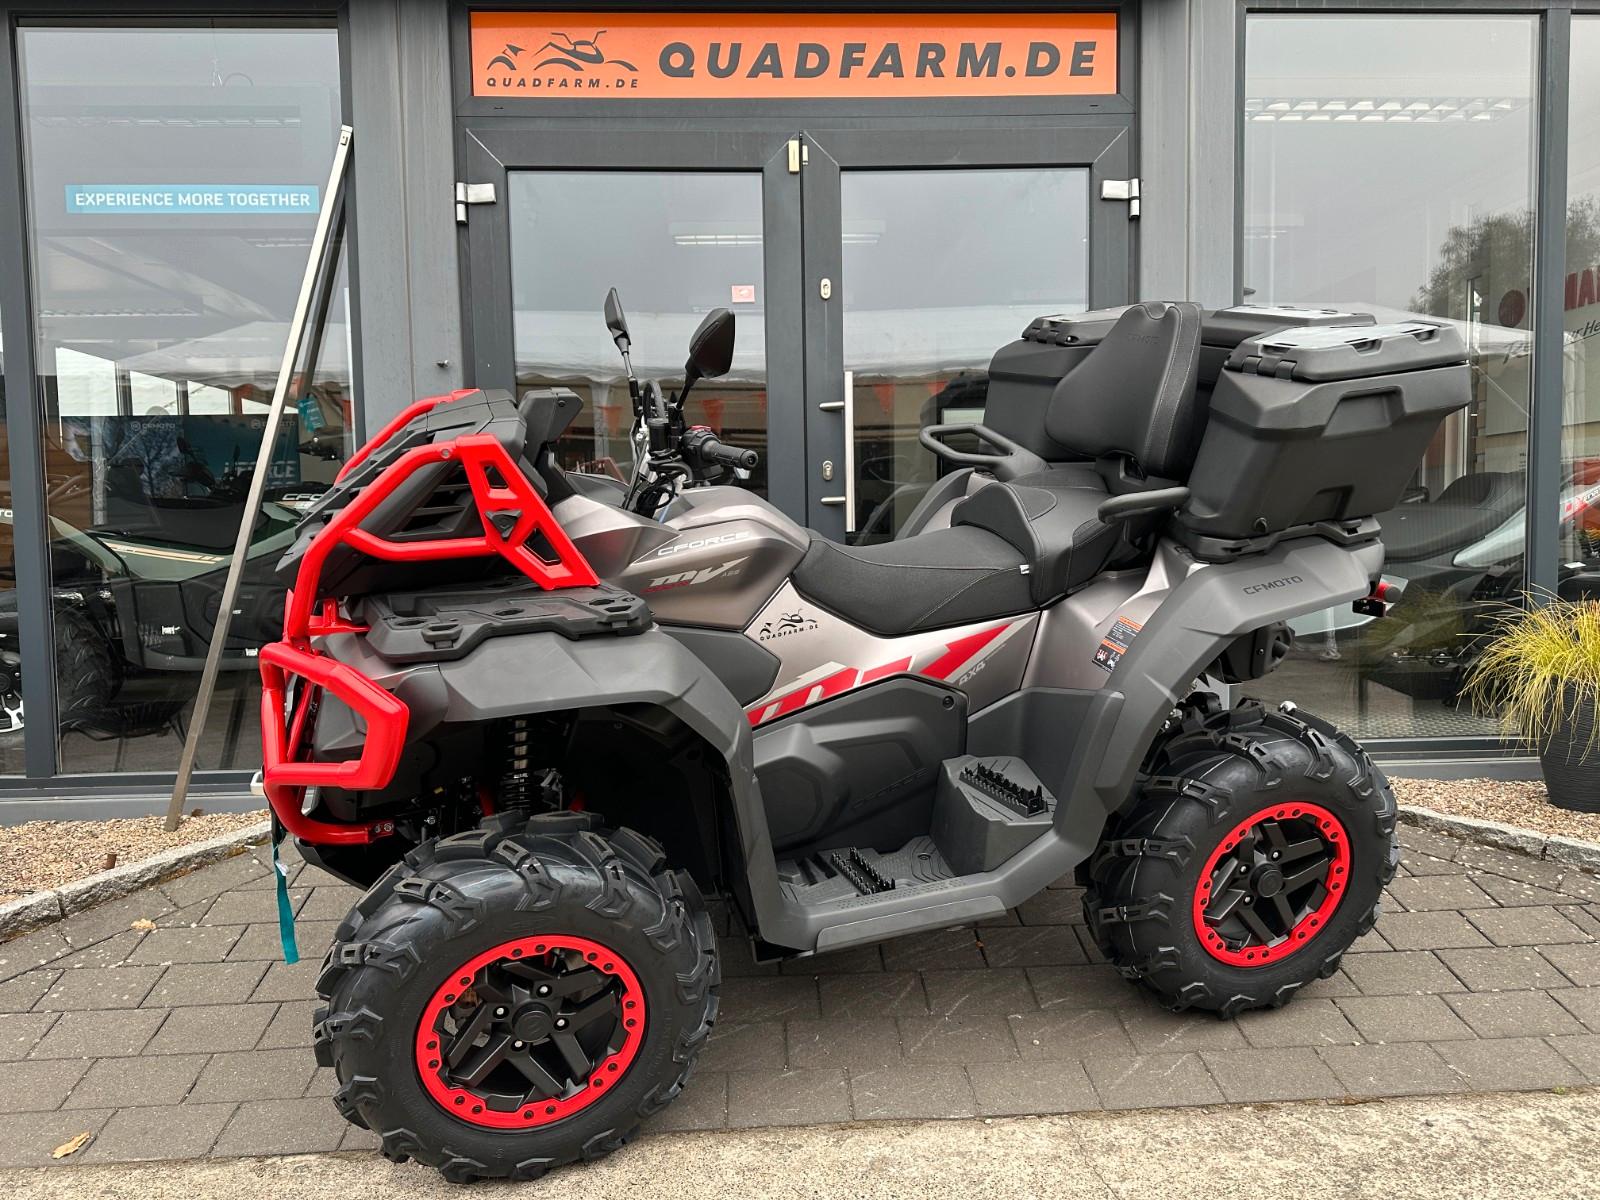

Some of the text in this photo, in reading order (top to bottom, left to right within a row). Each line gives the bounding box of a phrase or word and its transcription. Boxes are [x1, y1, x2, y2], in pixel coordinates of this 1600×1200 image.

[658, 41, 1096, 79] QUADFARM.DE
[486, 77, 639, 89] QUADFARM.DE
[75, 192, 311, 207] EXPERIENCE MORE TOGETHER
[657, 531, 752, 557] CFORCE
[1243, 575, 1304, 595] CFMOTO
[759, 624, 820, 641] QUADFARM.DE
